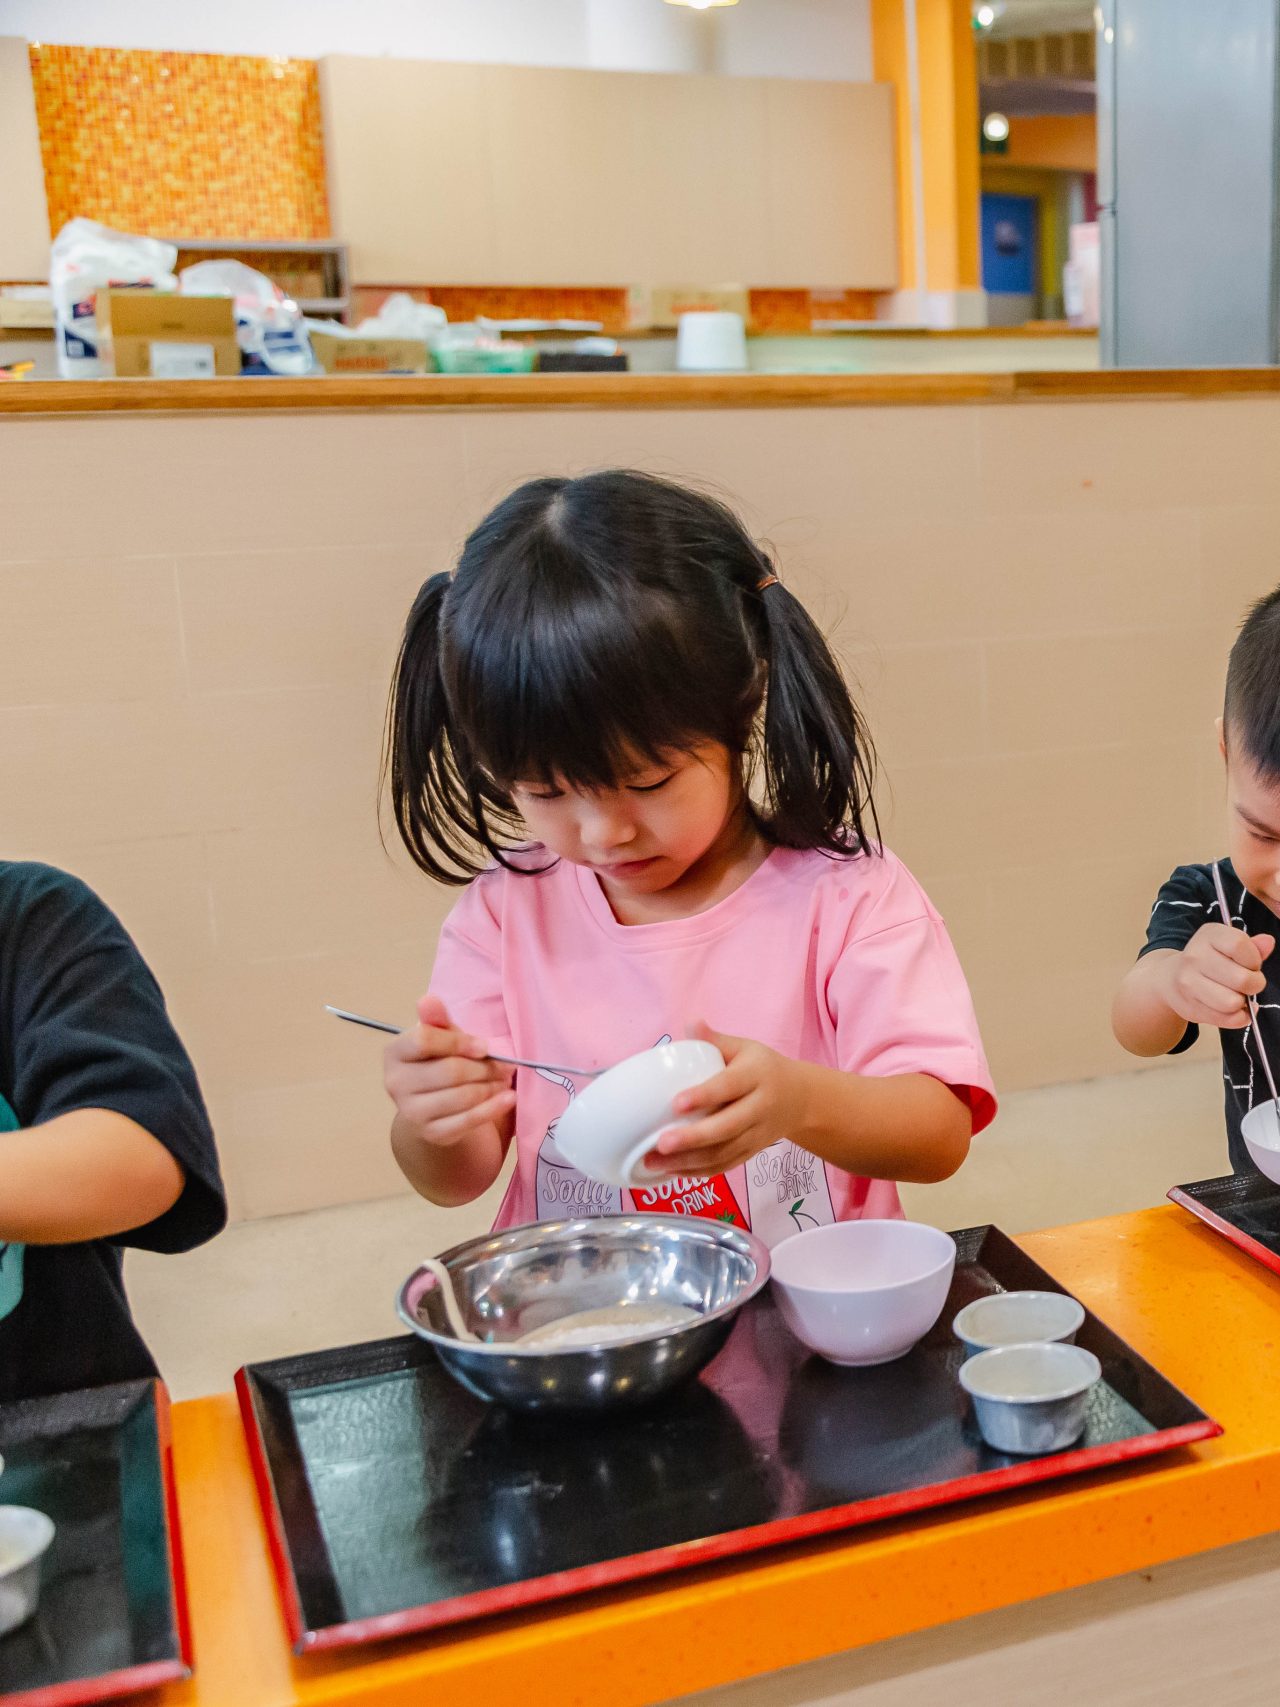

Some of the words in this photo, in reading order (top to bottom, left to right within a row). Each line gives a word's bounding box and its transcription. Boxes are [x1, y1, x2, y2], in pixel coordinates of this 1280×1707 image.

[753, 1142, 816, 1188] Soda
[542, 1168, 613, 1205] Soda
[671, 1182, 722, 1216] DRINK
[776, 1170, 818, 1204] DRINK
